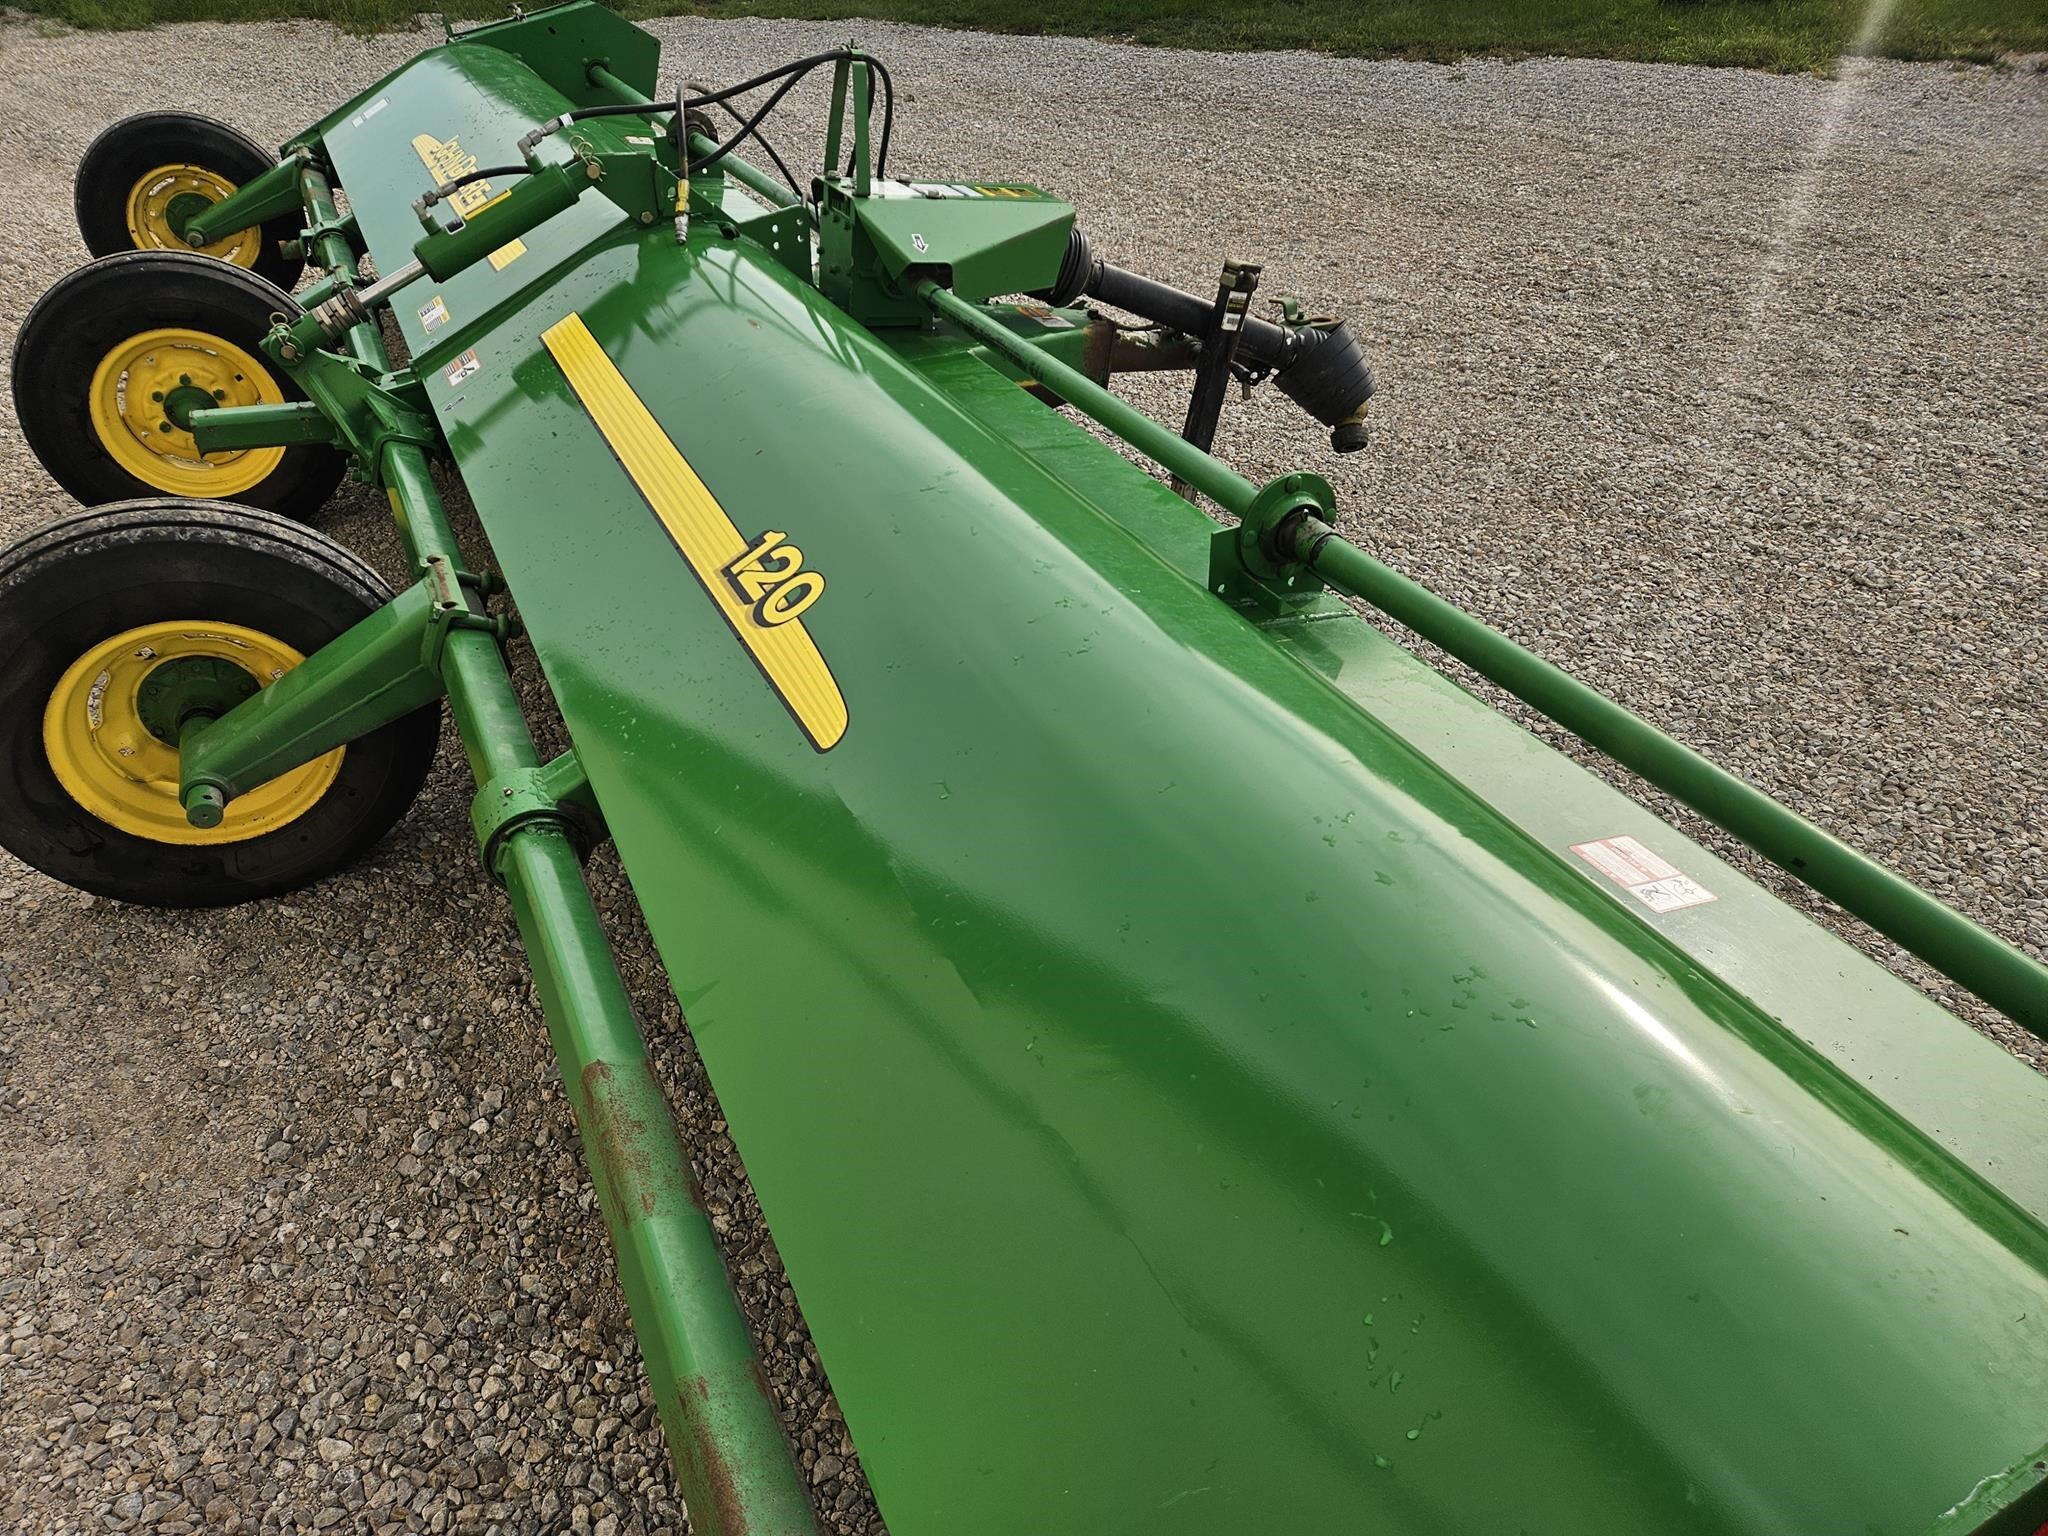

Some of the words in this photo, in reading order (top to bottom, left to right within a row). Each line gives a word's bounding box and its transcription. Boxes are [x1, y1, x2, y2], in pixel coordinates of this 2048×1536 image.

[430, 134, 468, 174] JOHN
[447, 154, 493, 207] DERE
[722, 530, 826, 628] 120
